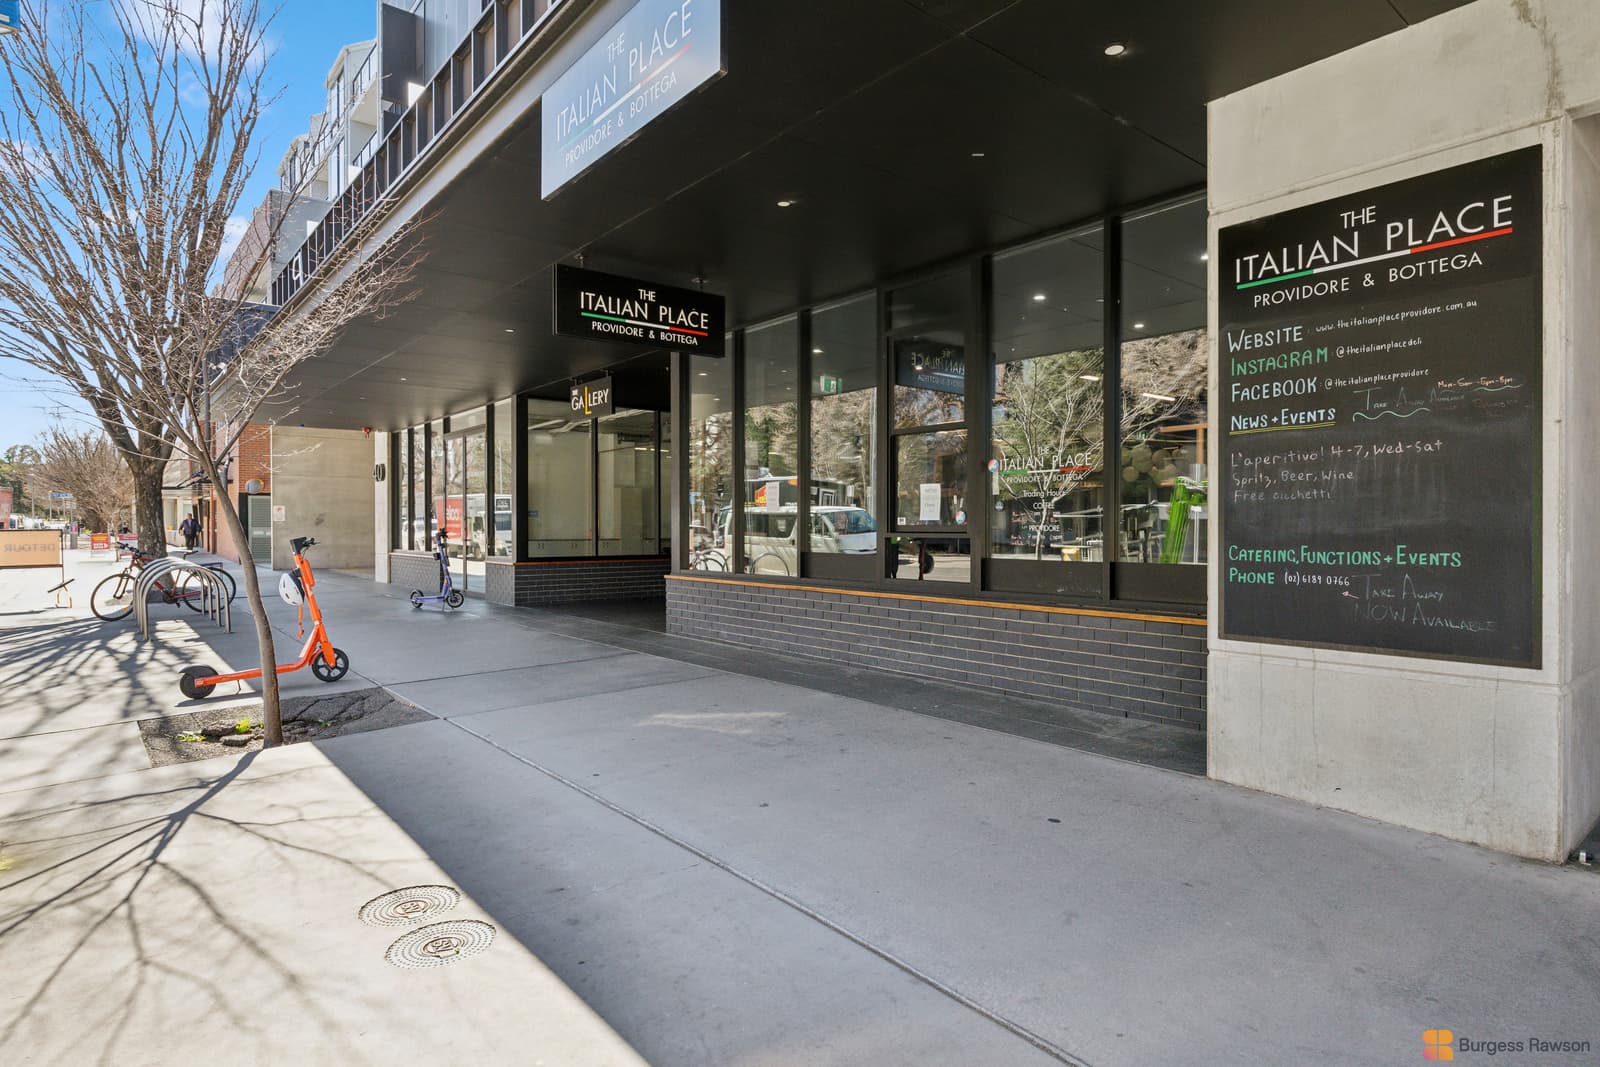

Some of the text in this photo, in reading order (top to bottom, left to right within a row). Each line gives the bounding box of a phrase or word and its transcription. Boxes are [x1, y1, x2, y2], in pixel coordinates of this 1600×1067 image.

[607, 32, 625, 64] THE
[556, 0, 692, 142] ITALIAN PLACE
[565, 71, 677, 169] PROVIDORE & BOTTEGA
[1340, 205, 1376, 229] THE
[1236, 195, 1512, 283] ITALIAN PLACE
[1254, 251, 1483, 308] PROVIDORE & BOTTEGA
[580, 291, 709, 329] ITALIAN PLACE
[638, 289, 656, 302] THE
[592, 320, 698, 345] PROVIDORE & BOTTEGA
[1227, 326, 1304, 353] WEBSITE
[1231, 346, 1328, 376] INSTAGRAM
[571, 384, 609, 415] GALLERY
[1231, 377, 1317, 402] FACEBOOK
[1000, 452, 1092, 471] ITALIAN PLACE
[1302, 574, 1322, 584] 6189
